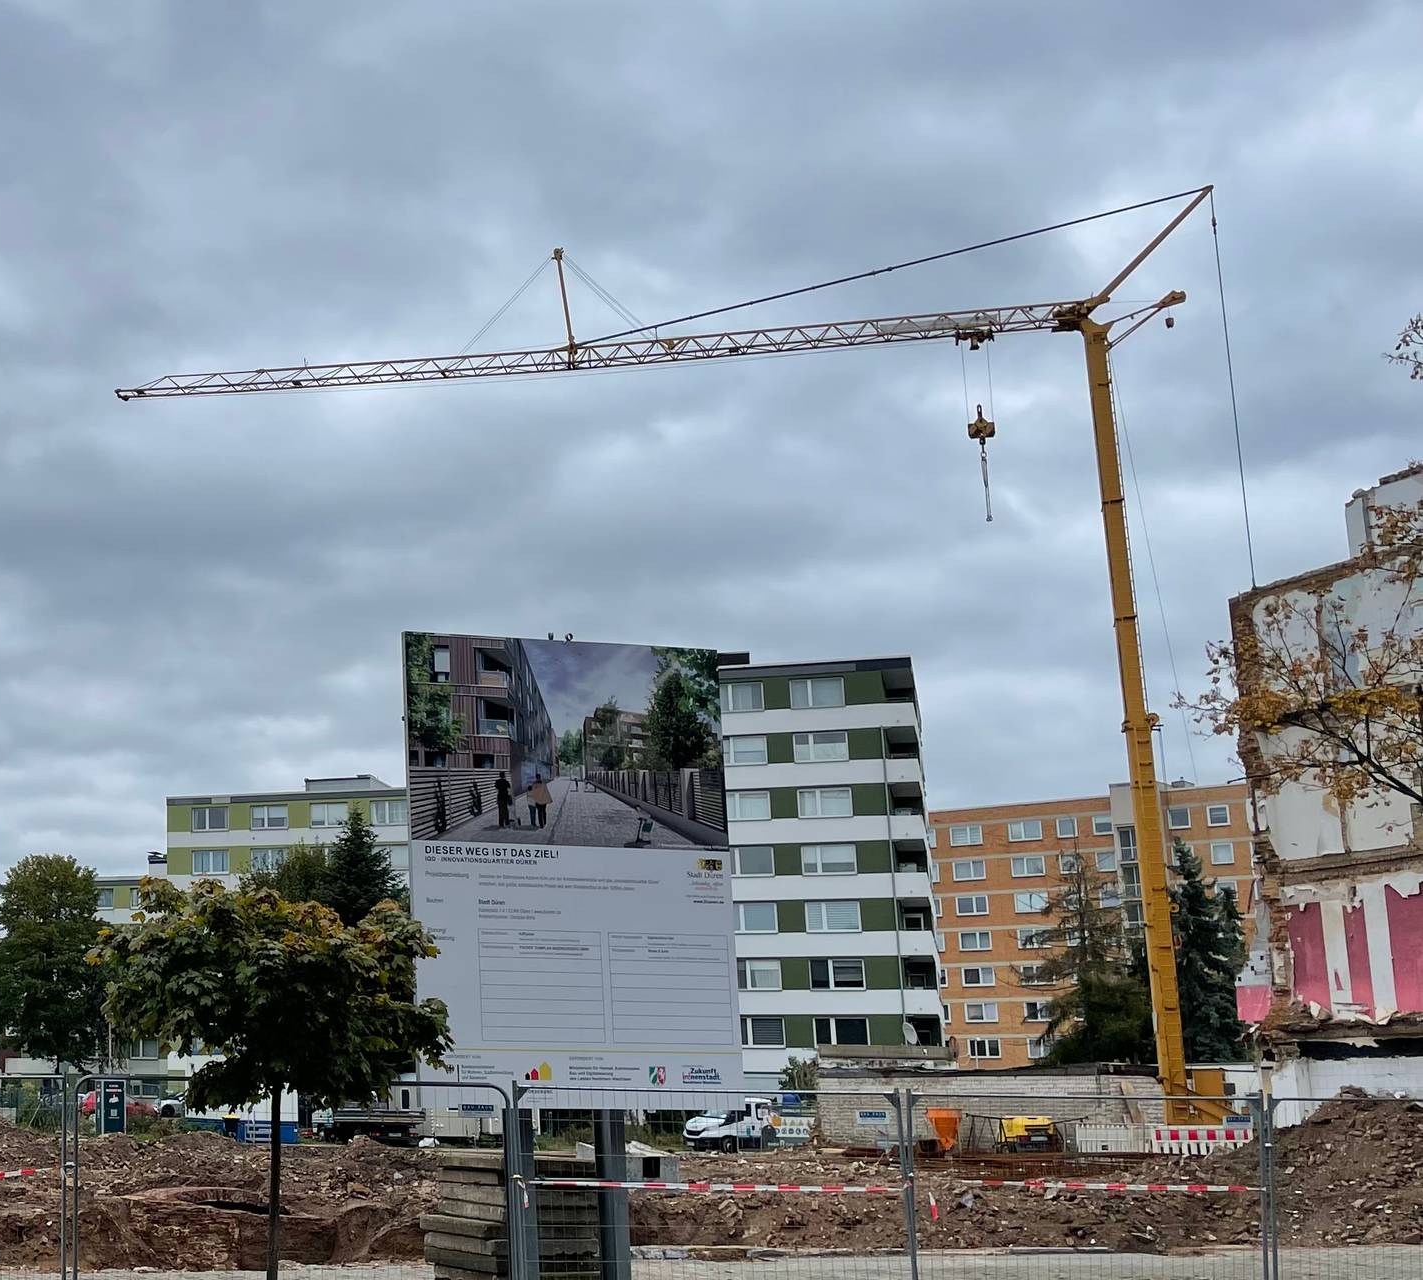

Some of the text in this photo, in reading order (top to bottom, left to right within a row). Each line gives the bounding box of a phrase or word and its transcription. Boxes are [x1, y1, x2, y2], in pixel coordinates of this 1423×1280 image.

[425, 845, 559, 859] DIESER WEG IST DAS ZIEL!
[441, 857, 514, 865] INNOVATIONSQUARTIER
[690, 1067, 717, 1075] Zukunft
